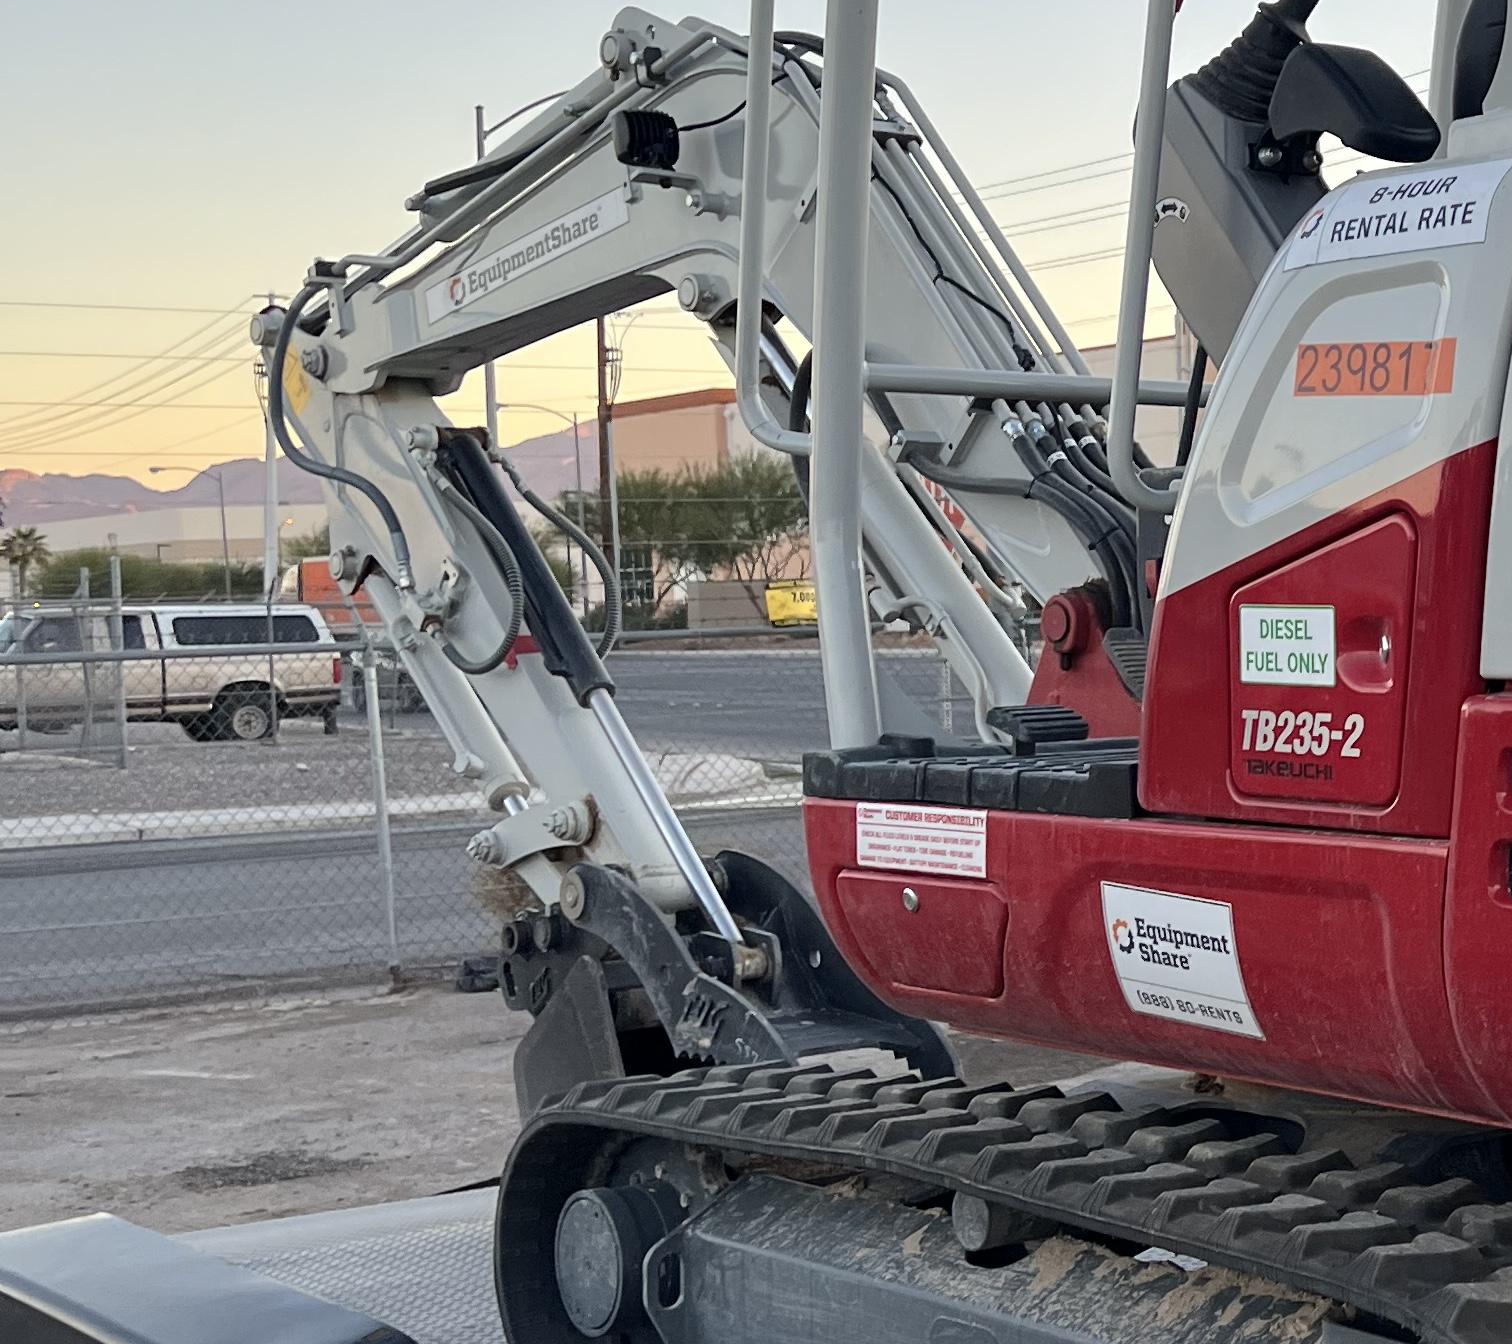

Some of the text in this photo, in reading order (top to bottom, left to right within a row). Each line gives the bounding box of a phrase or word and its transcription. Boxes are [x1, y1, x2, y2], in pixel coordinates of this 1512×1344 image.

[1369, 176, 1458, 204] 8-HOUR
[1330, 201, 1477, 243] RENTAL RATE
[468, 212, 600, 294] EquipmentShare
[1259, 619, 1313, 641] DIESEL
[1246, 651, 1329, 674] FUEL ONLY
[1241, 709, 1365, 758] TB235-2
[885, 810, 923, 822] CUSTOMER
[1134, 917, 1230, 955] Equipment
[1139, 943, 1191, 970] Share
[1136, 989, 1243, 1025] (888) 80-RENTS
